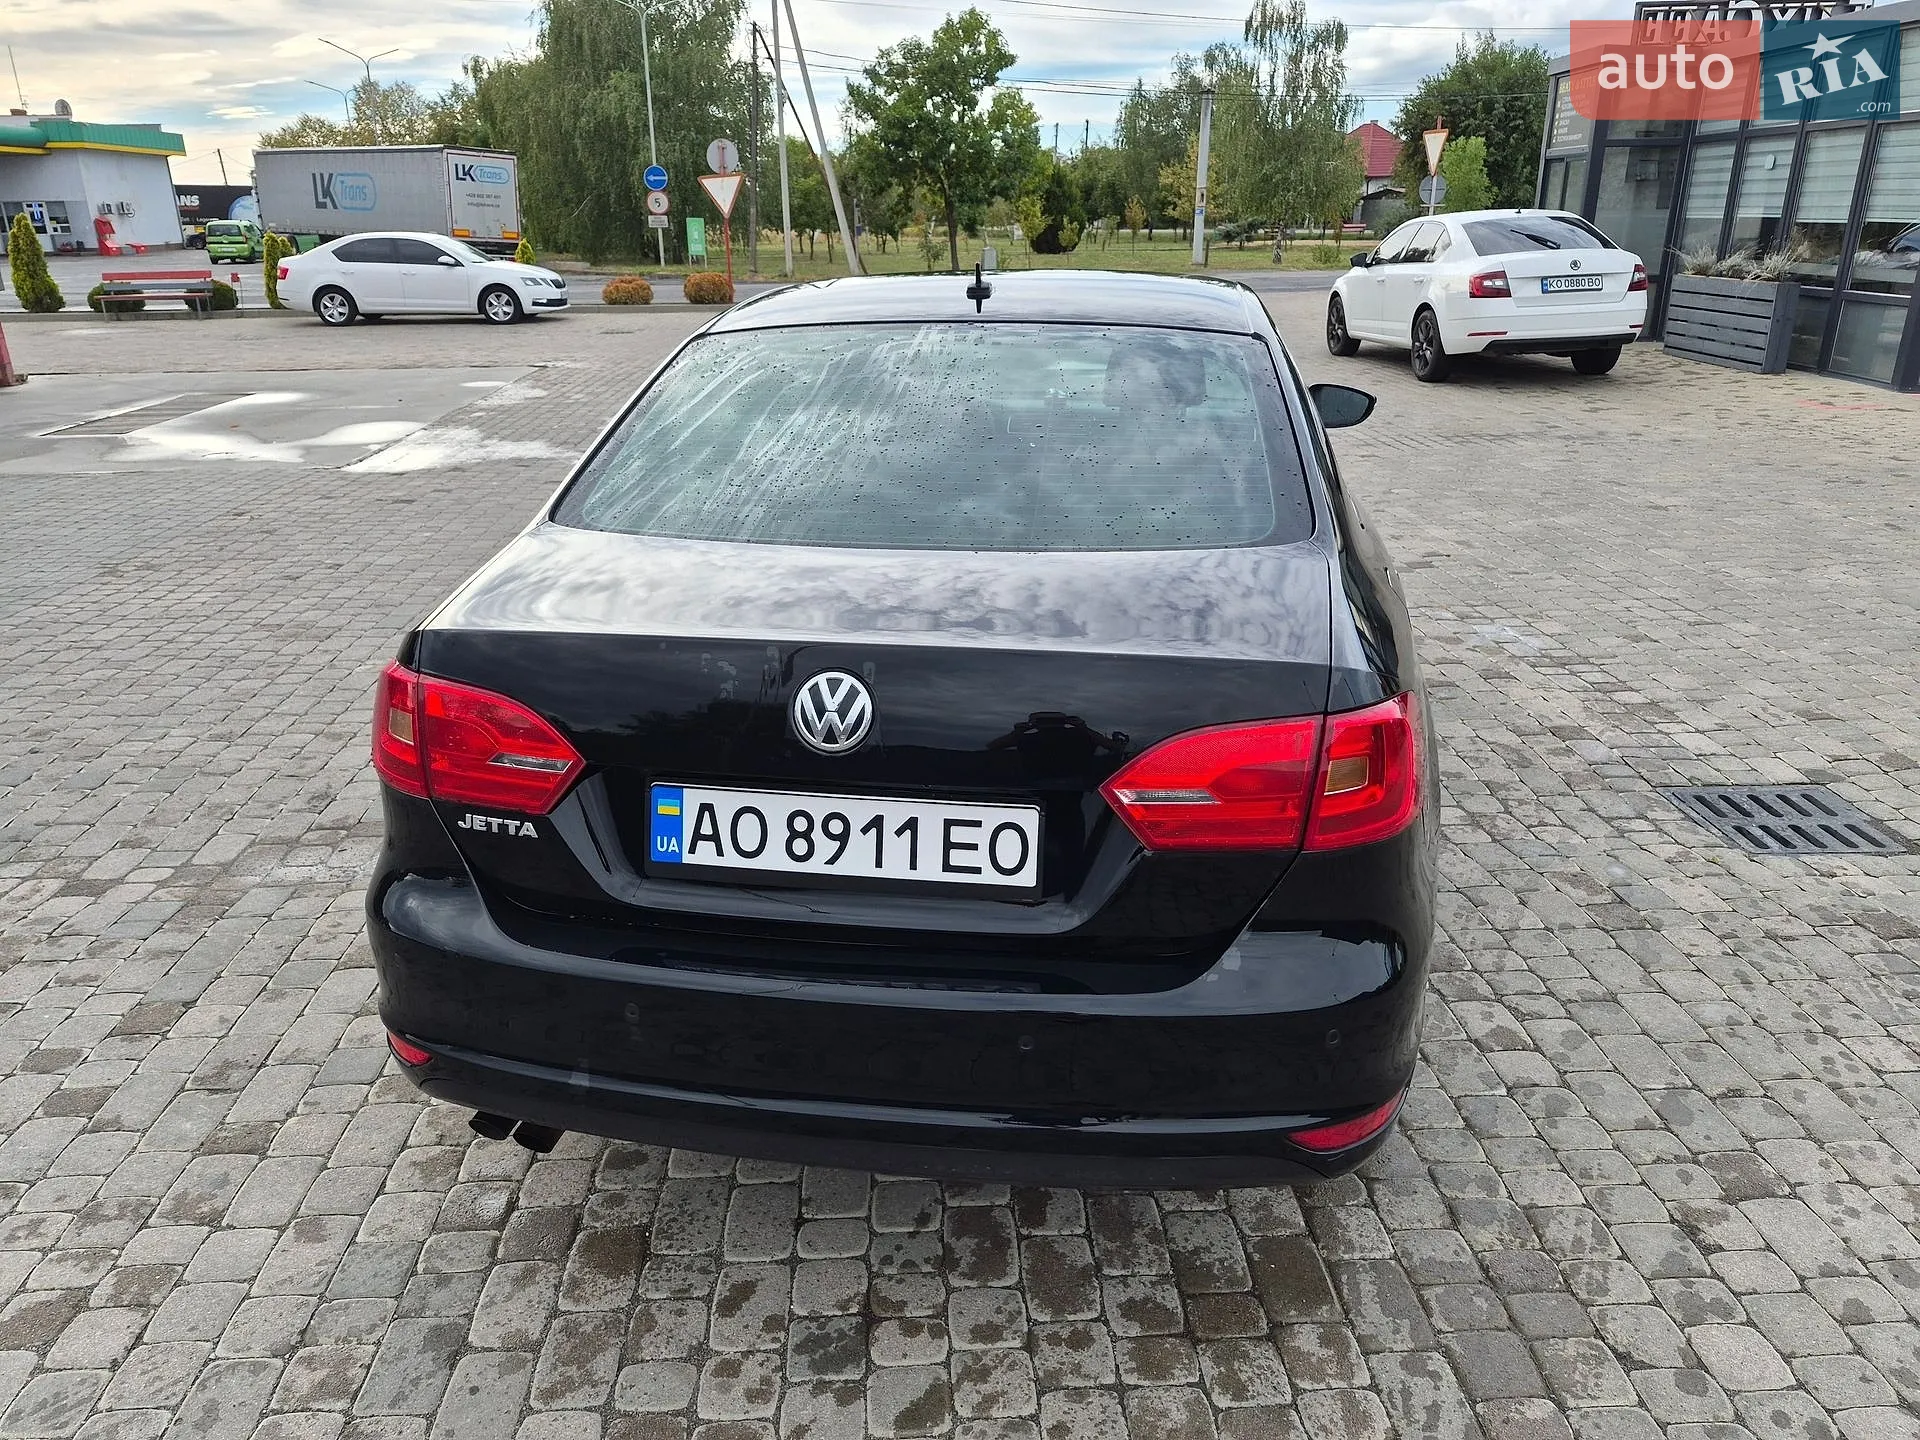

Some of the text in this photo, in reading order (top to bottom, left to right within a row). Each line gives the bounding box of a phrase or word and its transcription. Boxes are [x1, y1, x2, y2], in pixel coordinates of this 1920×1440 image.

[455, 163, 502, 182] LK Trans
[312, 173, 367, 209] LK Trans
[654, 198, 661, 208] 5
[1548, 277, 1601, 289] KO 0880 BO
[457, 813, 539, 839] JETTA
[656, 835, 679, 853] UA
[687, 801, 1030, 877] AO 8911 EO
